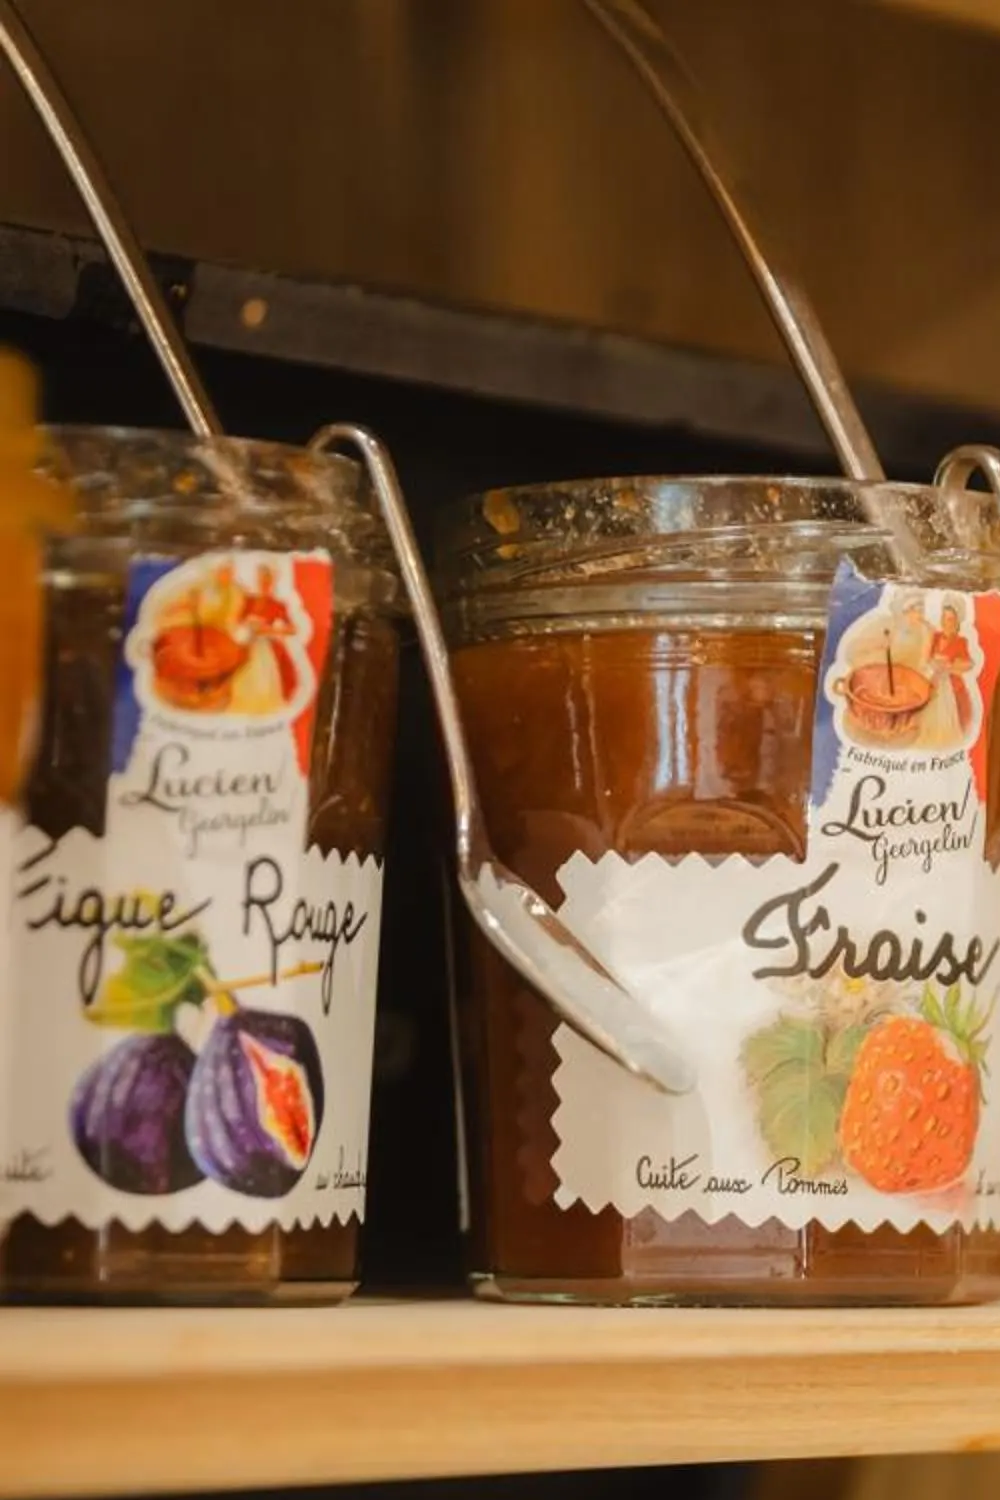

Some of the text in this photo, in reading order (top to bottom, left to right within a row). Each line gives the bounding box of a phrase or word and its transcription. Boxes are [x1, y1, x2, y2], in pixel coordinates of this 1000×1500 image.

[911, 761, 927, 773] en
[821, 775, 972, 841] Lucien
[872, 811, 978, 886] Georgelin
[242, 857, 368, 1017] Rouge
[741, 863, 1000, 986] Fraise
[636, 1153, 702, 1191] Cuite
[703, 1176, 752, 1195] aux
